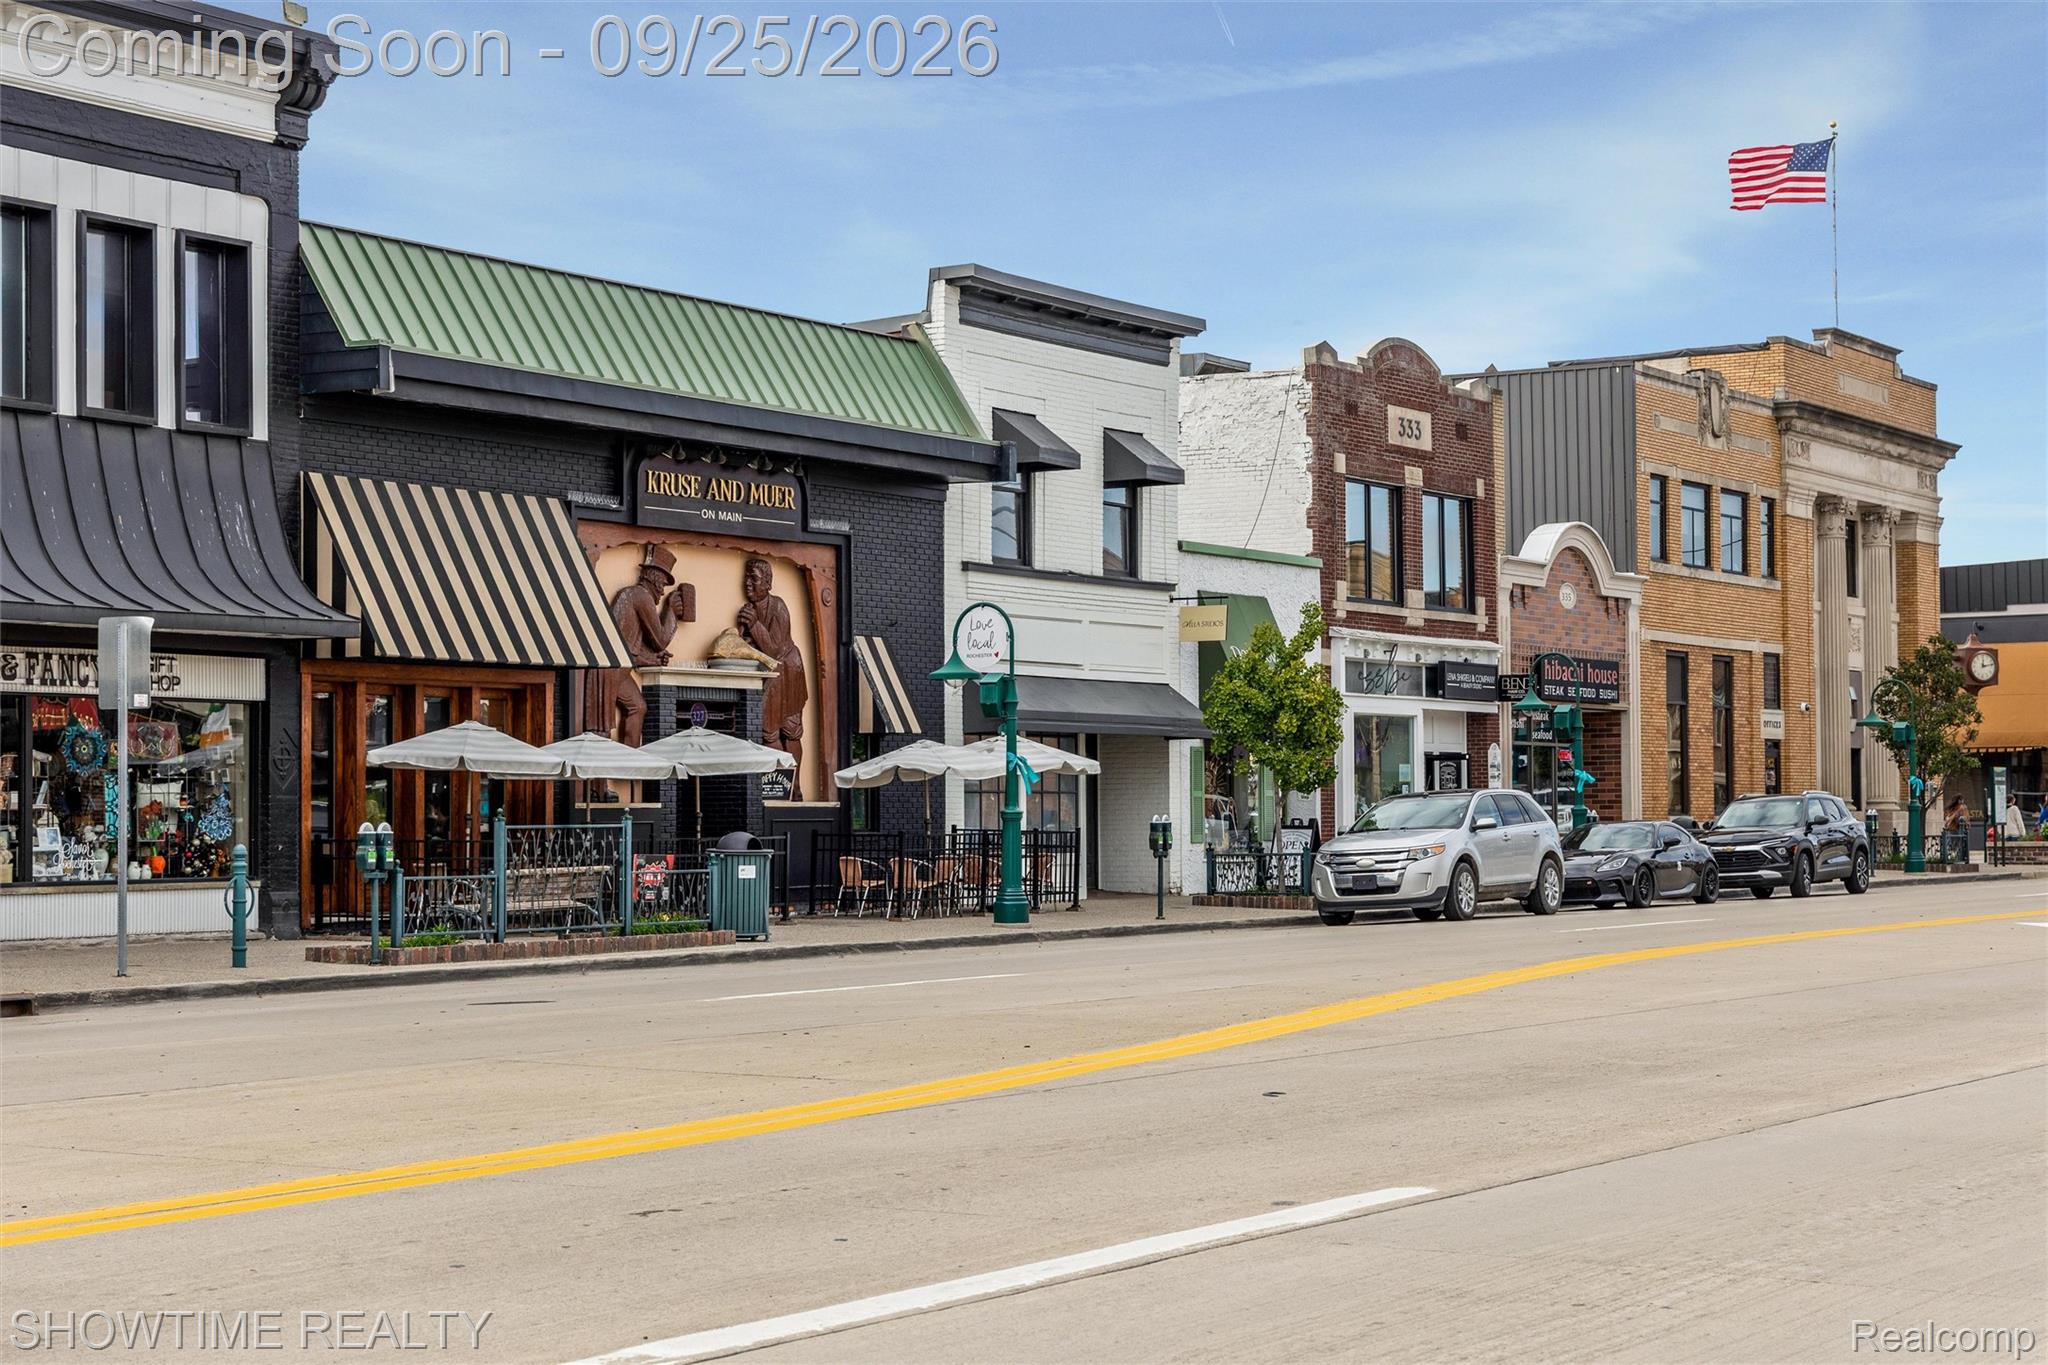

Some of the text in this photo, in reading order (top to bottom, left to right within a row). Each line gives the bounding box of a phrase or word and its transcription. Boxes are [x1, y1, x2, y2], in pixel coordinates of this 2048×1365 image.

[1398, 416, 1422, 441] 333
[646, 469, 796, 510] KRUSE AND MUER
[701, 508, 743, 522] ON MAIN
[969, 615, 994, 632] Love
[967, 630, 997, 650] local
[1, 653, 19, 681] &
[1587, 663, 1618, 685] house
[150, 675, 181, 692] HOP
[1544, 685, 1618, 700] STEAK SEFOOD SUSHI
[692, 710, 705, 722] 327
[1763, 720, 1782, 729] OFFICES
[1531, 729, 1553, 740] seafood
